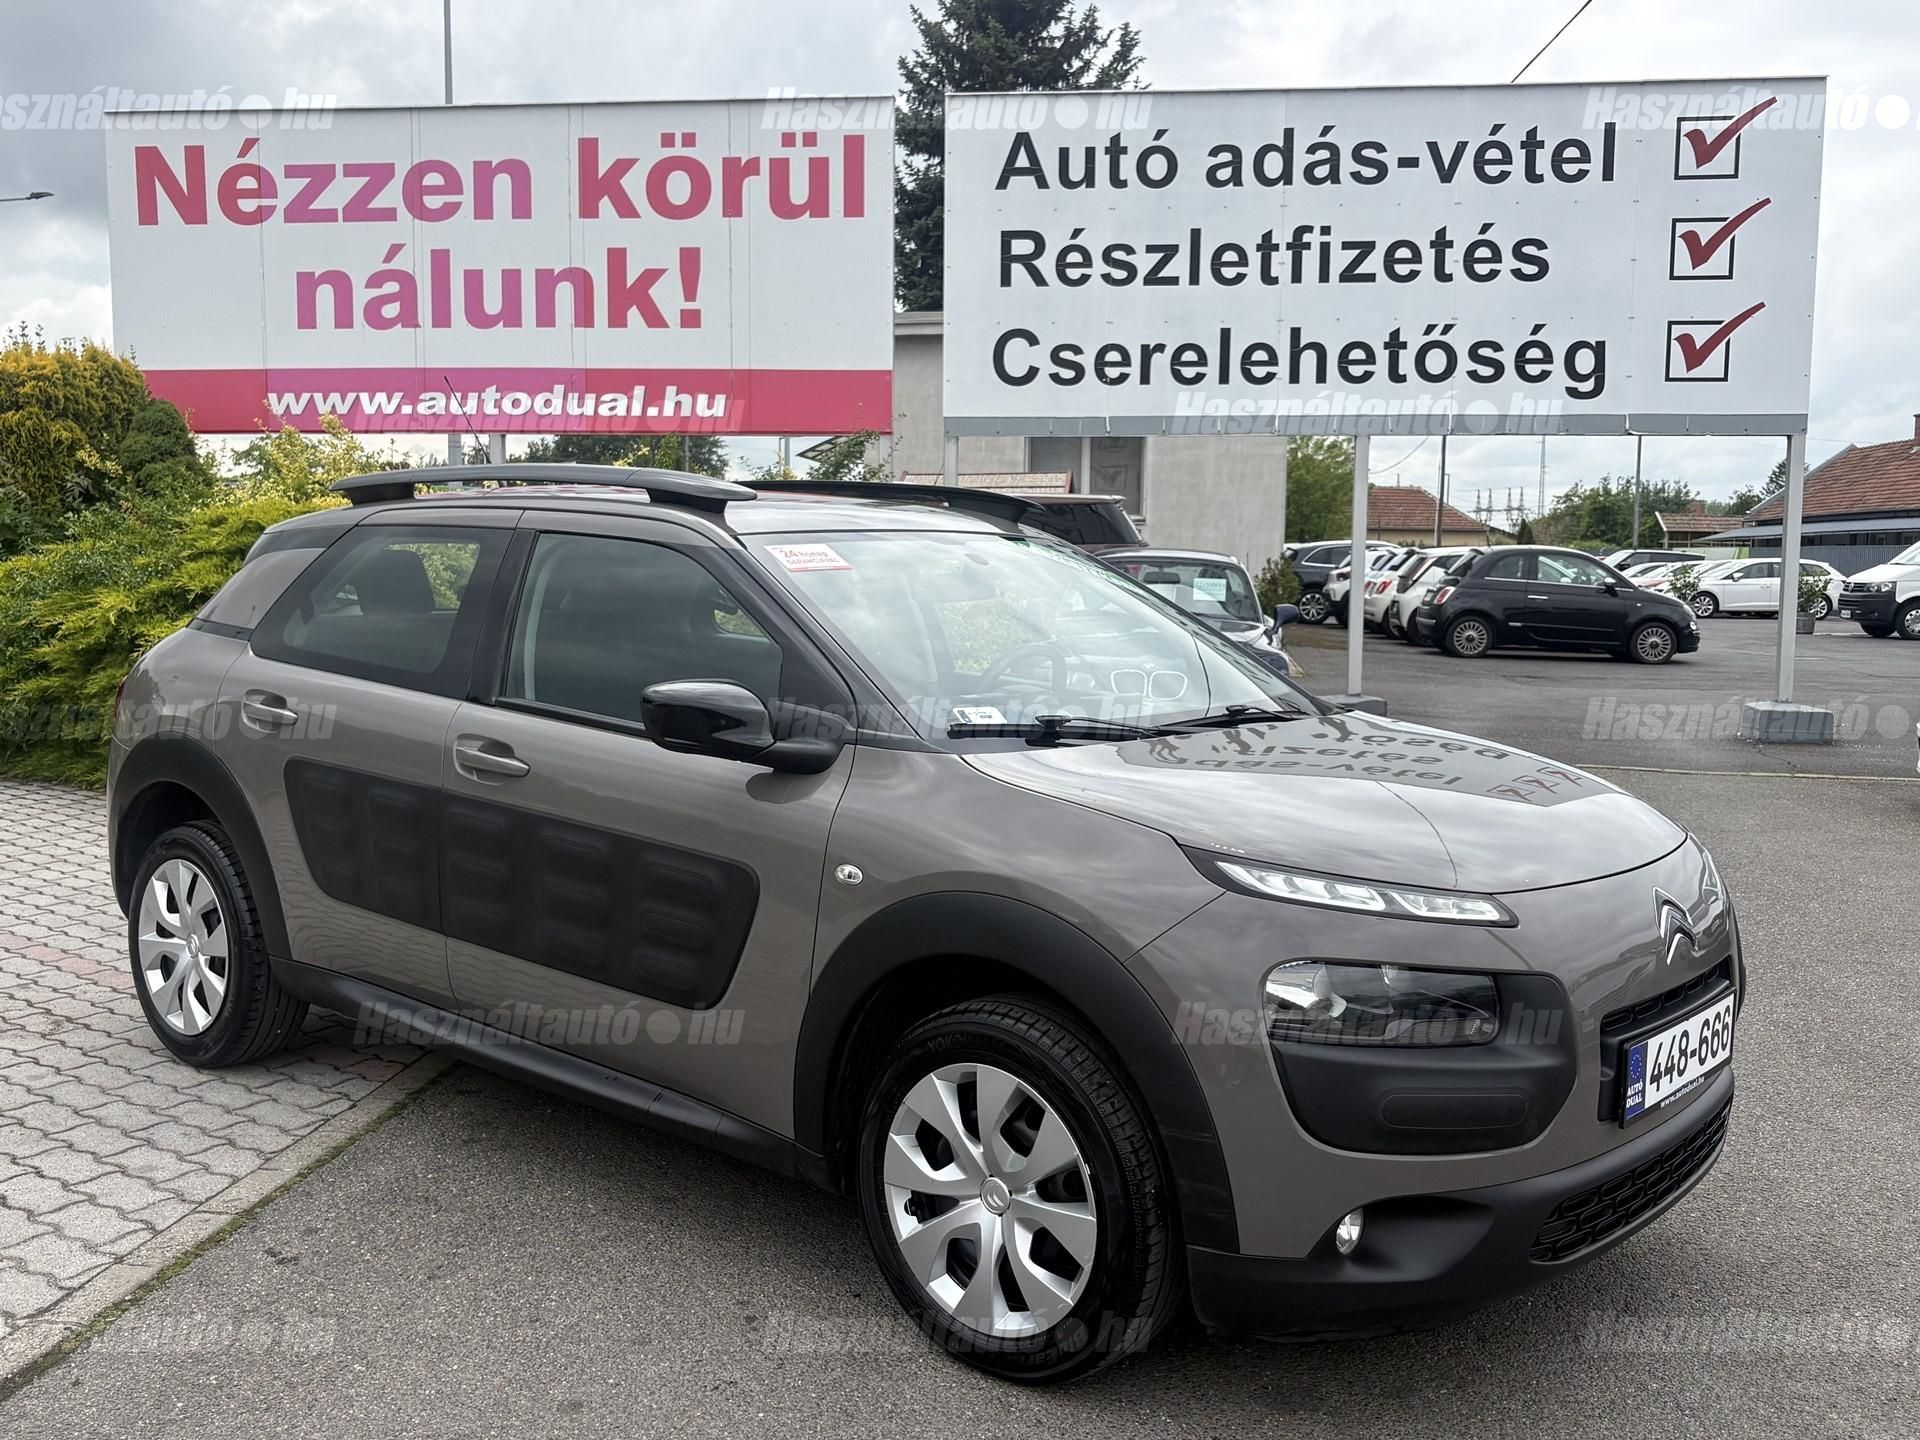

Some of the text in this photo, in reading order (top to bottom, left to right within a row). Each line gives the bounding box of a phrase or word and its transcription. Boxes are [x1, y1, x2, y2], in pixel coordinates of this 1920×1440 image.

[135, 132, 865, 227] Nézzen körül
[995, 121, 1617, 191] Autó adás-vétel
[296, 243, 702, 331] nálunk!
[1001, 222, 1551, 288] Részletfizetés
[993, 323, 1607, 400] Cserelehetőség
[267, 385, 727, 418] www.autodual.hu
[1650, 1004, 1731, 1093] 448-666
[1626, 1094, 1643, 1108] DUAL
[1627, 1079, 1643, 1097] AUTÓ
